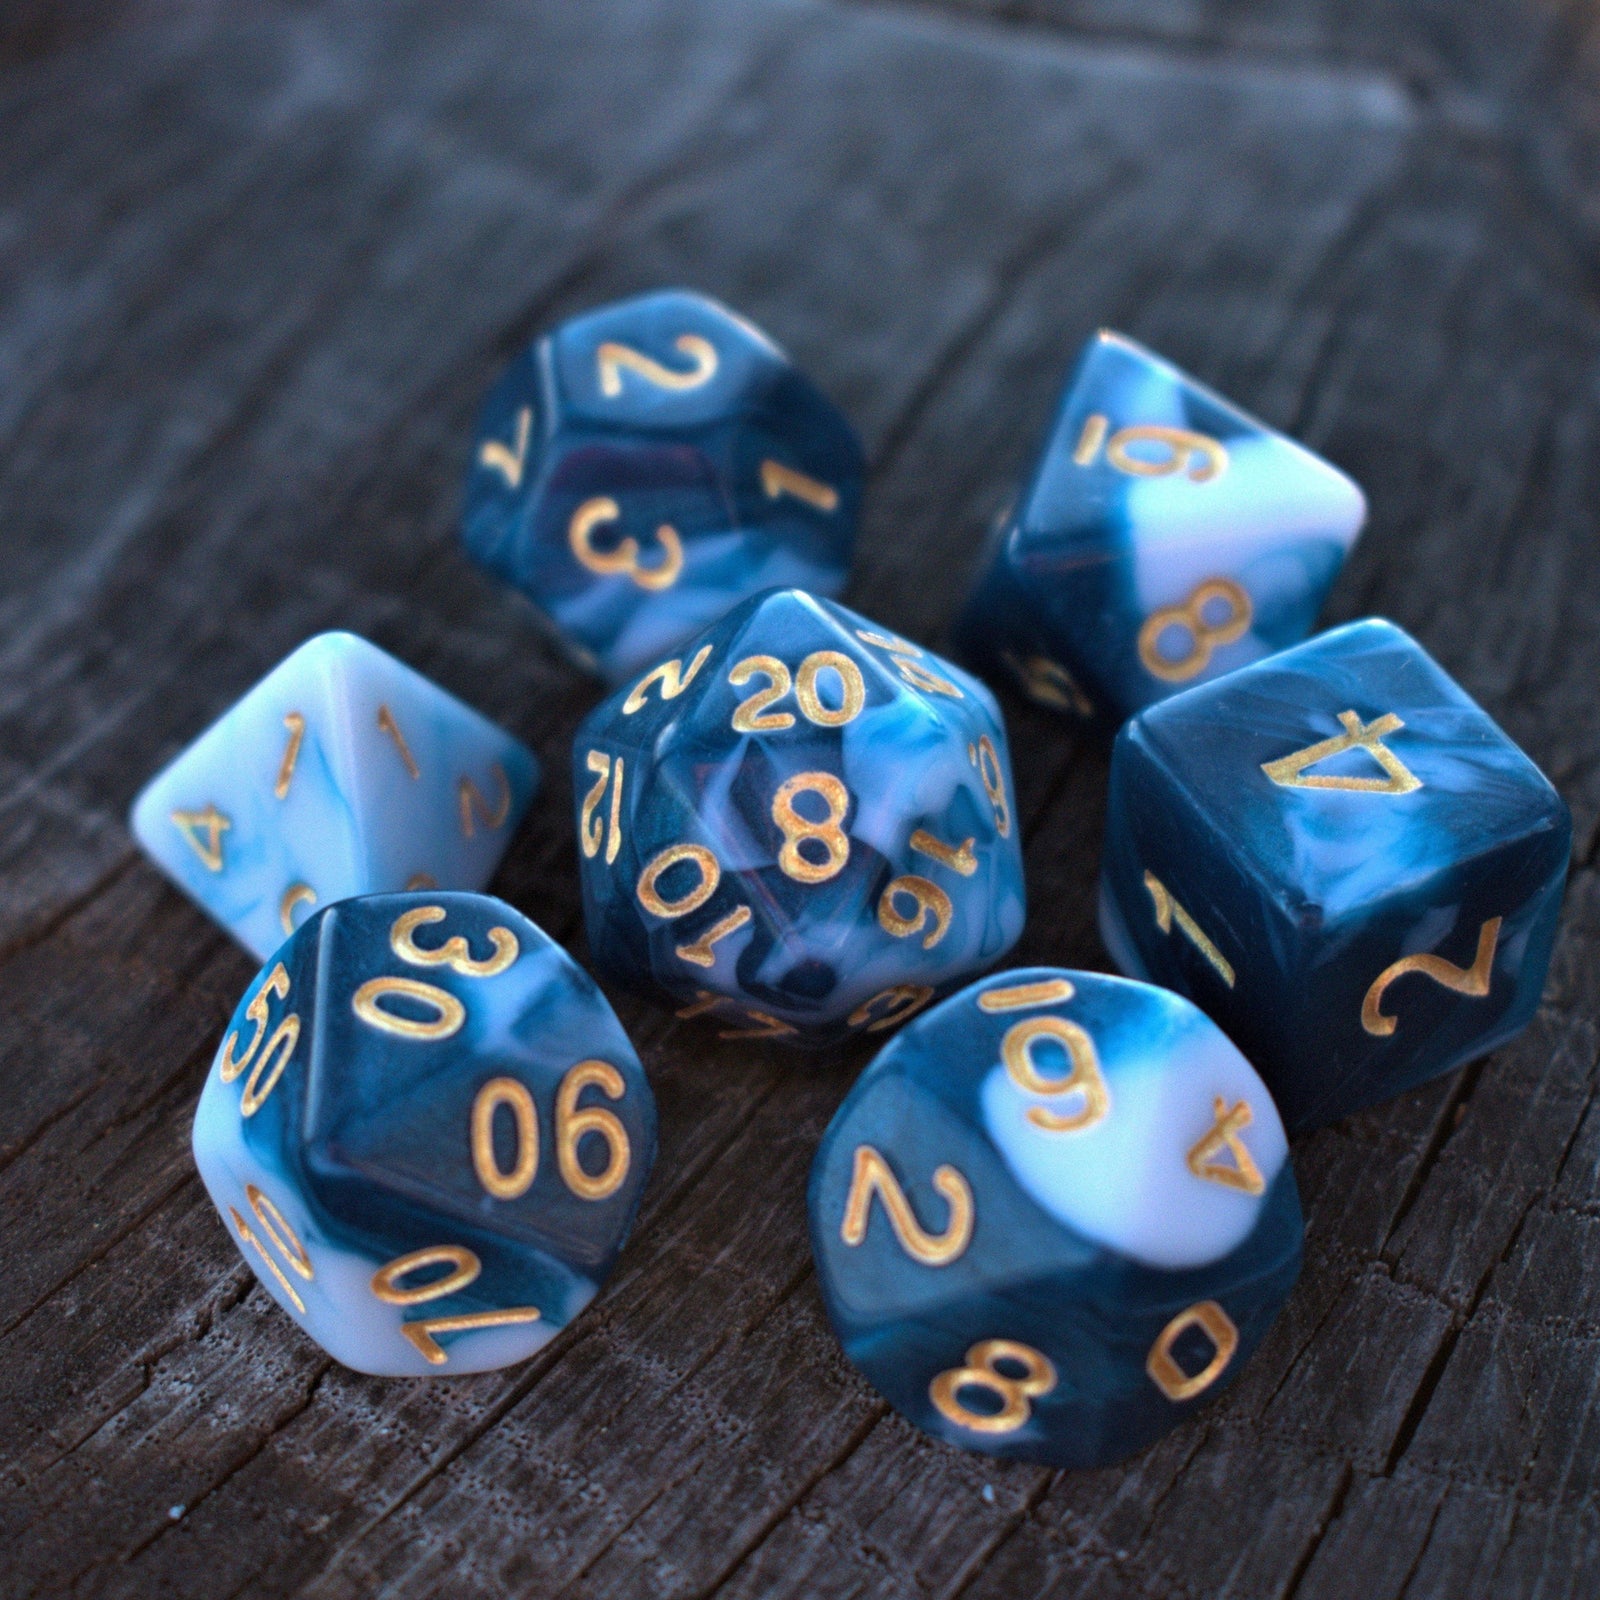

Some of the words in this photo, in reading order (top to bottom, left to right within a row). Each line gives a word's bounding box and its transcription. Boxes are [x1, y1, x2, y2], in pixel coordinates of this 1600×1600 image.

[599, 334, 717, 396] 2
[760, 459, 838, 513] 1
[569, 497, 683, 590] 3
[622, 645, 713, 714] 2
[1138, 578, 1253, 683] 8
[377, 704, 420, 780] 1
[728, 651, 865, 733] 20
[275, 711, 304, 799] 1
[457, 763, 510, 837] 2
[1260, 709, 1424, 795] 4
[171, 804, 230, 871] 4
[580, 750, 624, 865] 12
[772, 771, 850, 884] 8
[636, 843, 752, 967] 10
[877, 829, 978, 950] 16
[1143, 868, 1236, 990] 1
[352, 906, 520, 1042] 30
[848, 985, 934, 1032] 3
[1361, 916, 1503, 1037] 2
[220, 962, 301, 1118] 50
[1185, 1095, 1265, 1196] 4
[227, 1183, 315, 1315] 10
[841, 1144, 975, 1266] 2
[370, 1244, 542, 1366] 70
[1146, 1299, 1239, 1400] 0
[928, 1338, 1058, 1434] 8
